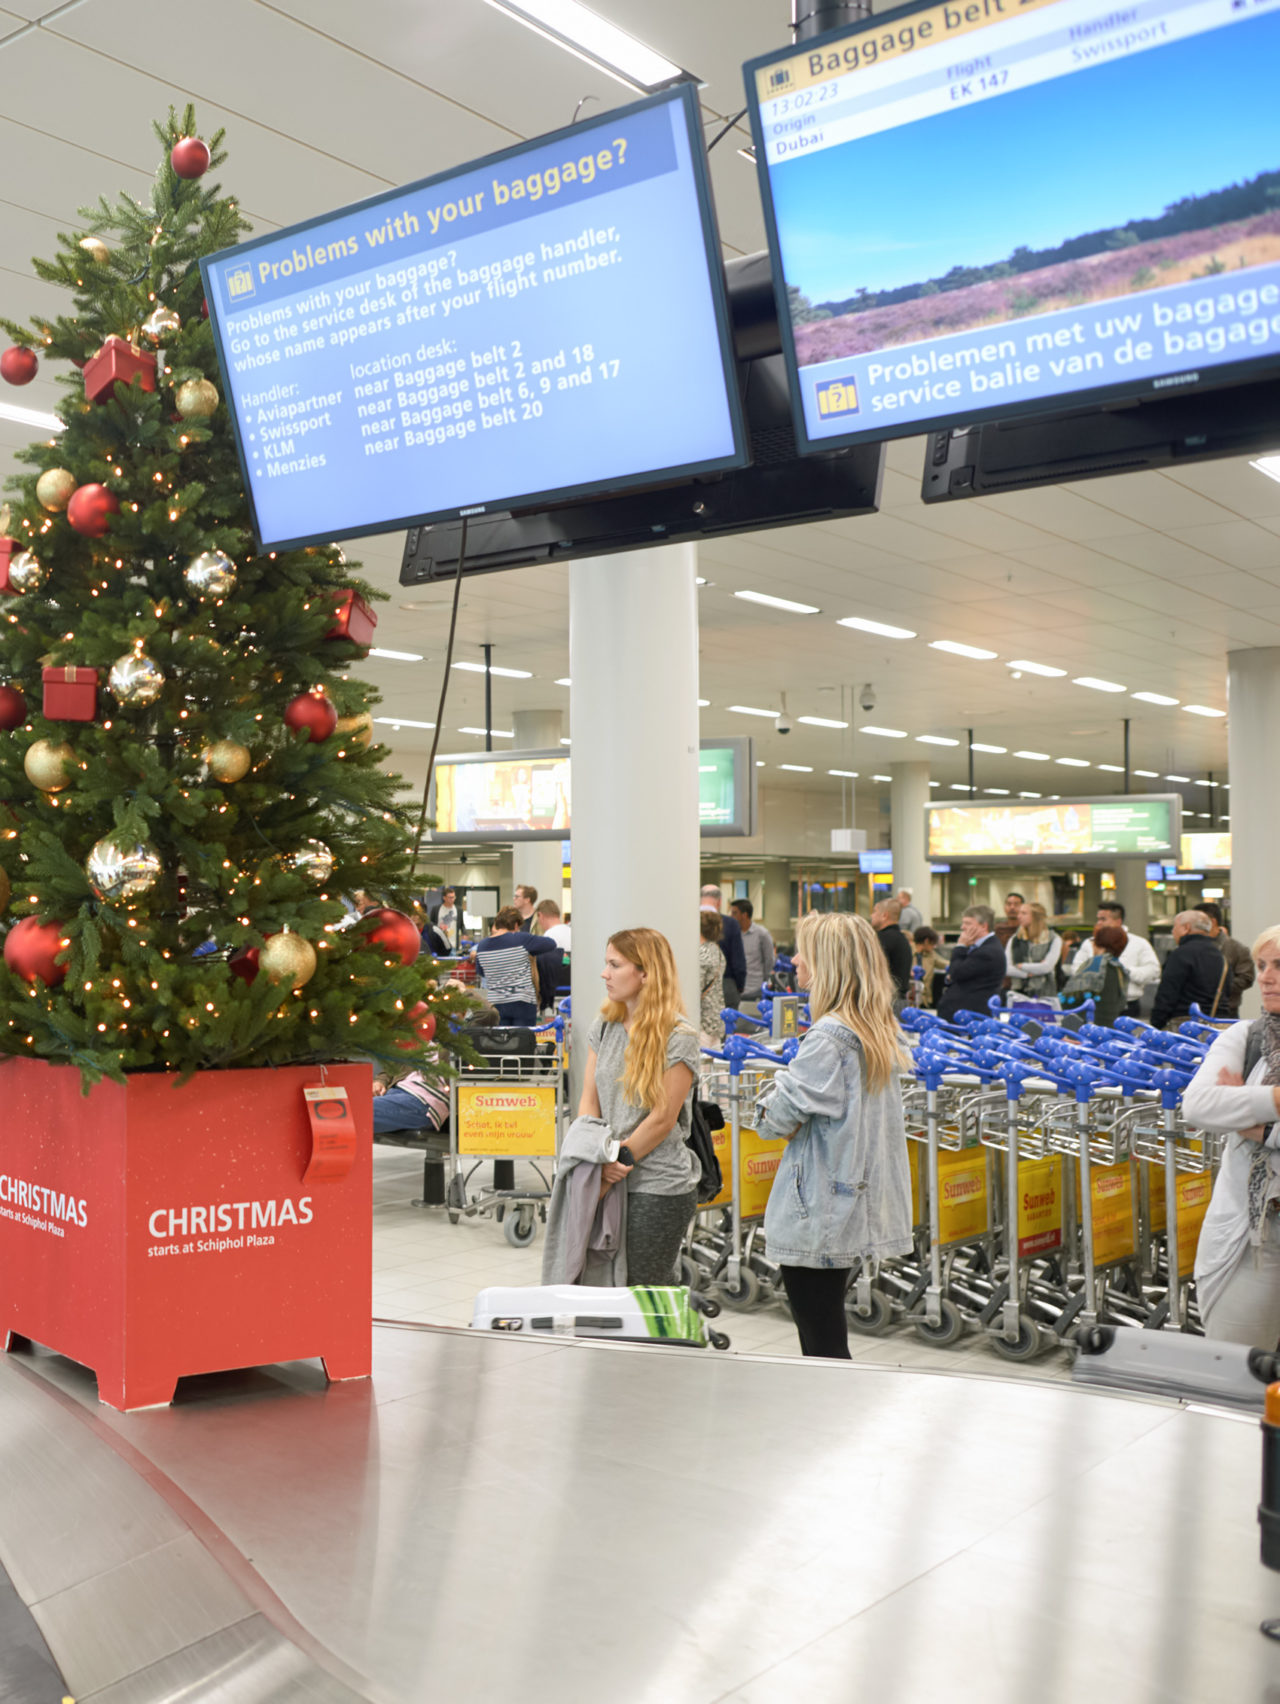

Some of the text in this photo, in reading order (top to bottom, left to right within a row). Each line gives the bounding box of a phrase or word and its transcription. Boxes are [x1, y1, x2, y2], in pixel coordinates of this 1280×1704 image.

[1070, 8, 1138, 40] Handler
[1072, 20, 1168, 63] Swissport
[808, 20, 933, 78] Baggage
[946, 55, 993, 81] Flight
[949, 70, 1009, 101] EK 147
[772, 82, 839, 118] 13:02:23
[773, 112, 816, 136] Origin
[776, 129, 824, 156] Dubai
[258, 138, 627, 284] Problems with your baggage?
[226, 249, 457, 337] Problems with your baggage?
[230, 226, 620, 355] Go to the service desk of the baggage handler,
[233, 248, 623, 373] whose name appears after your flight number.
[868, 283, 1280, 386] Problemen met uw bagage
[349, 338, 457, 380] location desk:
[354, 340, 523, 400] near Baggage belt 2
[871, 379, 961, 413] service
[969, 362, 1041, 394] balie
[1048, 351, 1104, 377] van
[1114, 337, 1154, 365] de
[240, 382, 301, 409] Handler:
[357, 343, 595, 419] near Baggage belt 2 and 18
[361, 358, 621, 438] near Baggage belt 6, 9 and 17
[257, 390, 343, 425] Aviapartner
[260, 411, 332, 443] Swissport
[364, 400, 543, 457] near Baggage belt 20
[263, 438, 295, 460] KLM
[267, 453, 327, 478] Menzies
[475, 1095, 537, 1107] Sunweb
[944, 1175, 982, 1201] Sunweb
[1023, 1187, 1055, 1211] Sunweb
[15, 1212, 22, 1222] at
[22, 1212, 47, 1232] Schiphol
[48, 1221, 65, 1238] Plaza
[148, 1196, 314, 1239] CHRISTMAS
[147, 1234, 276, 1257] starts at Schiphol Plaza
